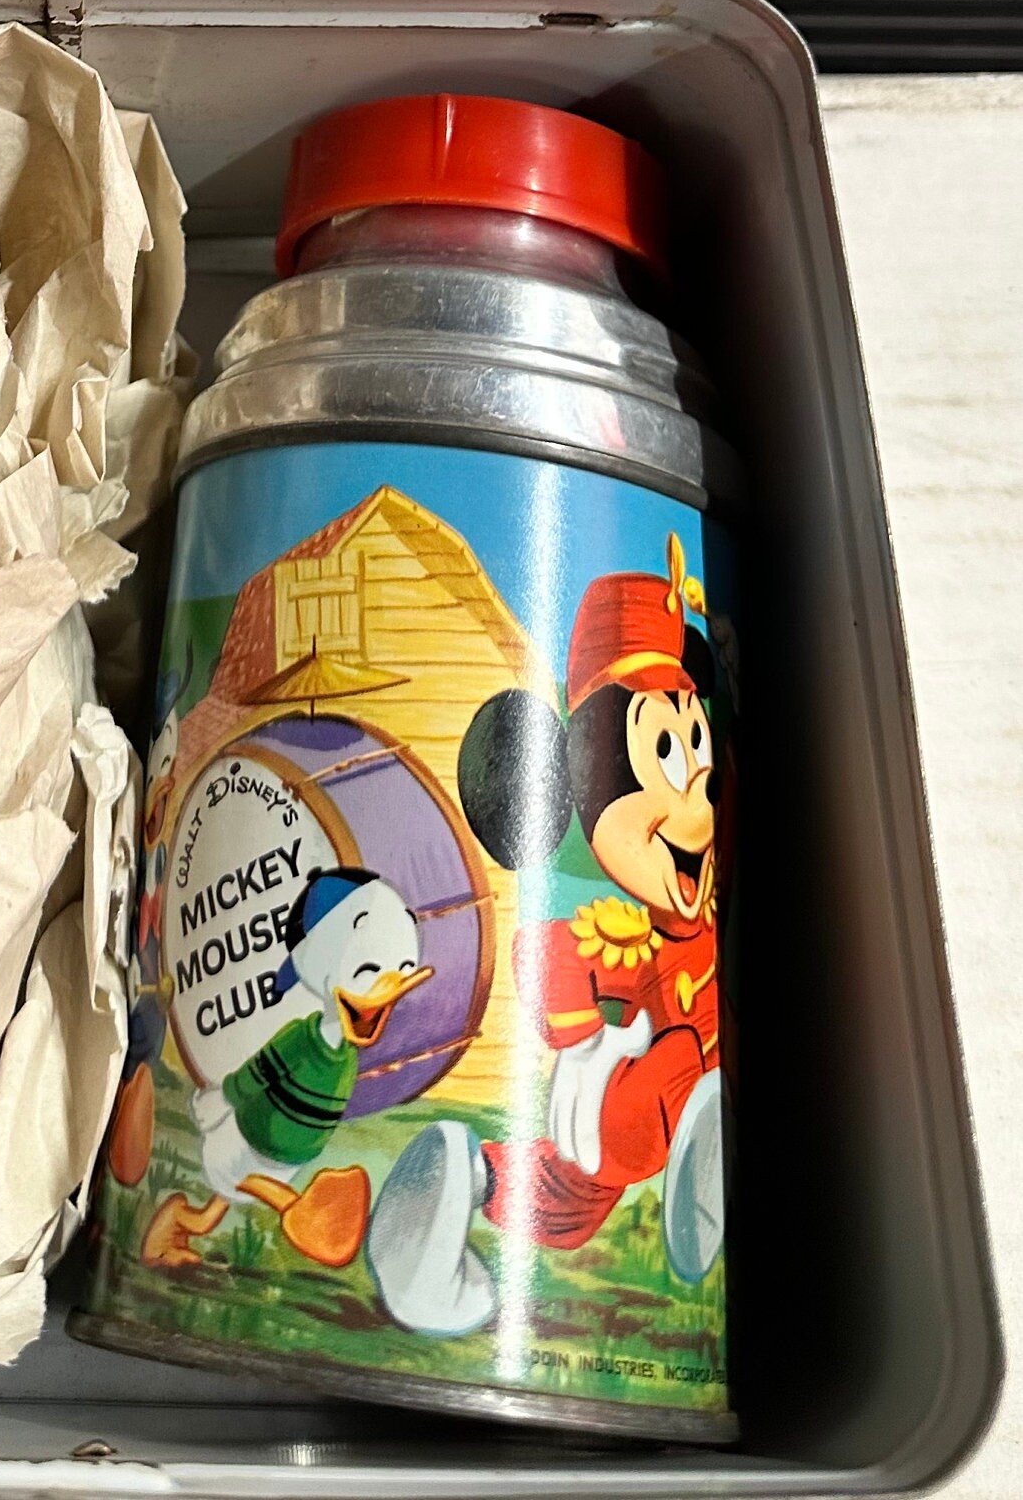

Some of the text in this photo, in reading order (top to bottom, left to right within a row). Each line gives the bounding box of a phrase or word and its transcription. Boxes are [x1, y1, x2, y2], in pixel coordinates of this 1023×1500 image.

[176, 808, 204, 889] WALT
[179, 838, 303, 937] MICKEY
[176, 902, 292, 995] MOUSE
[195, 970, 285, 1038] CLUB
[578, 1355, 658, 1382] INDUSTRIES,
